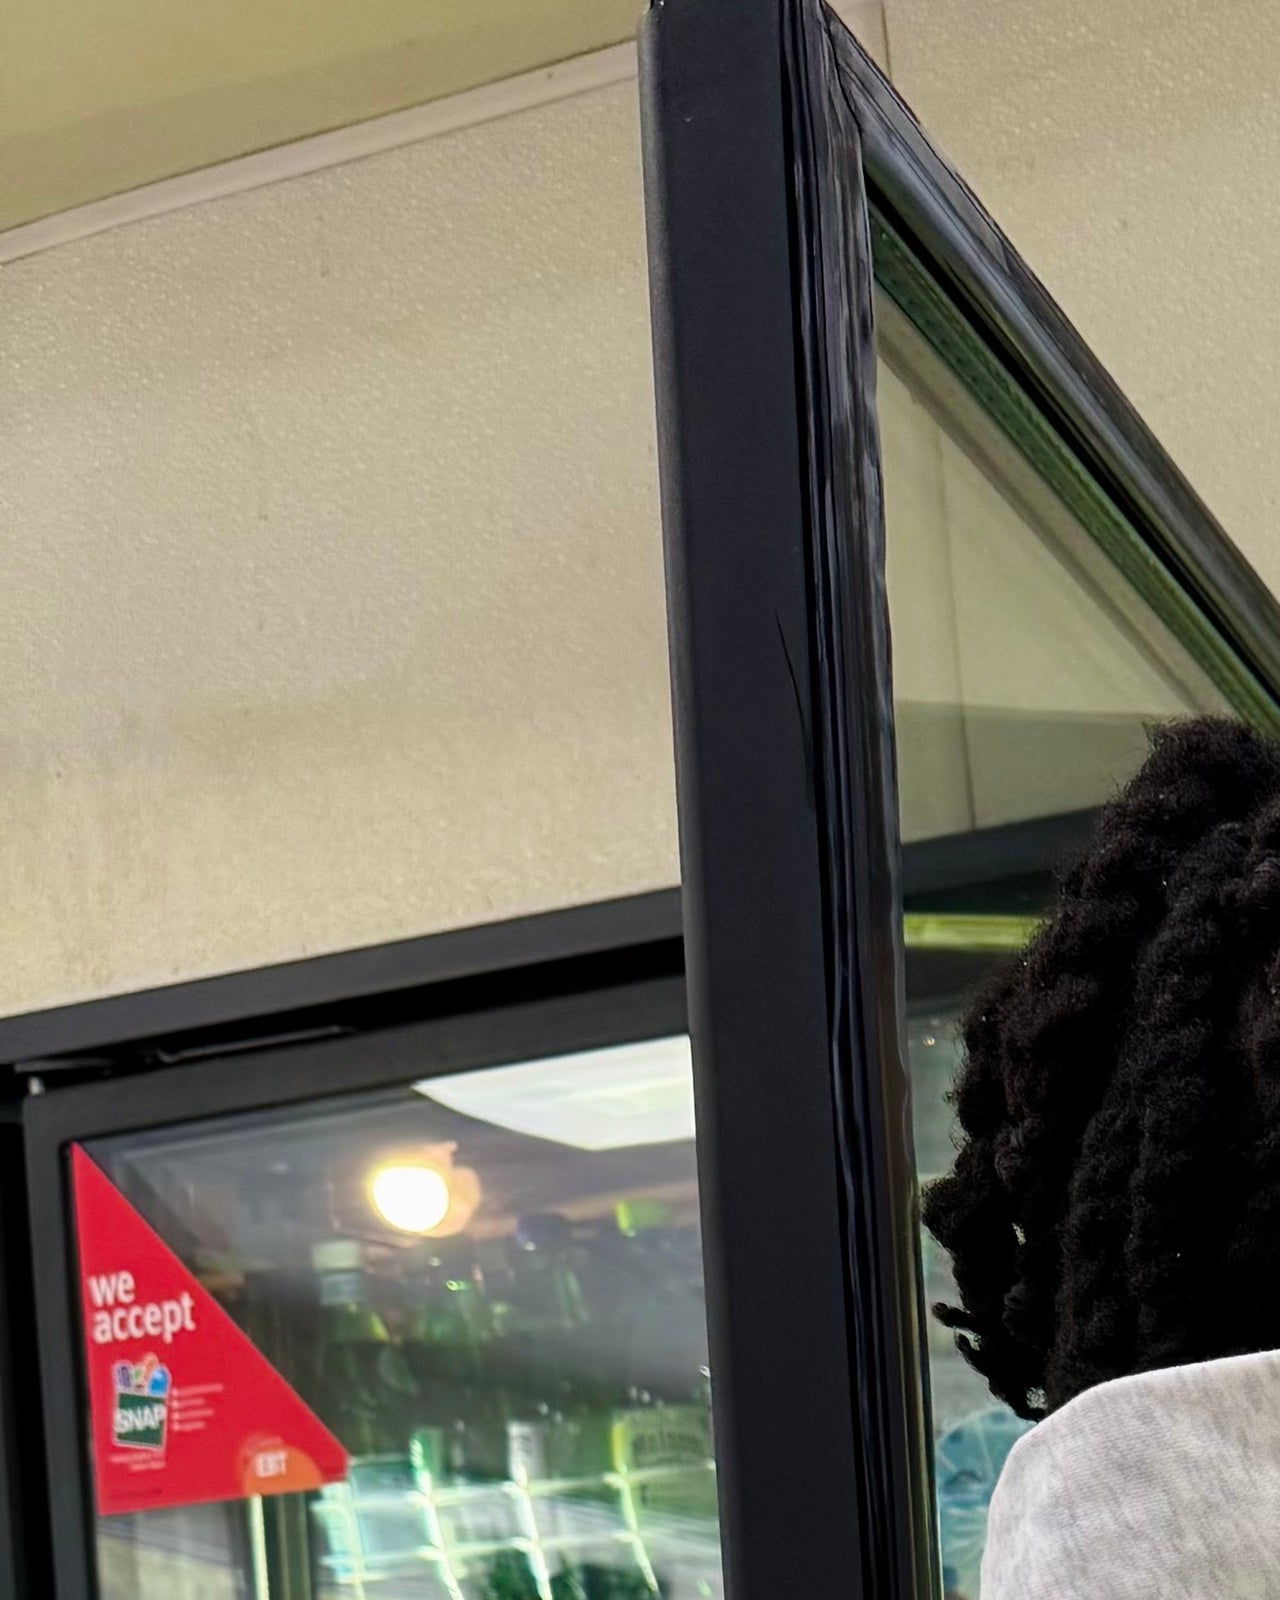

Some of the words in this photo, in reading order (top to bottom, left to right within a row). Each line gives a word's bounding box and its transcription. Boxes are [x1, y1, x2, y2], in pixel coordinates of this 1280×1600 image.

[87, 1270, 136, 1307] we
[92, 1292, 197, 1344] accept
[114, 1403, 167, 1434] SNAP
